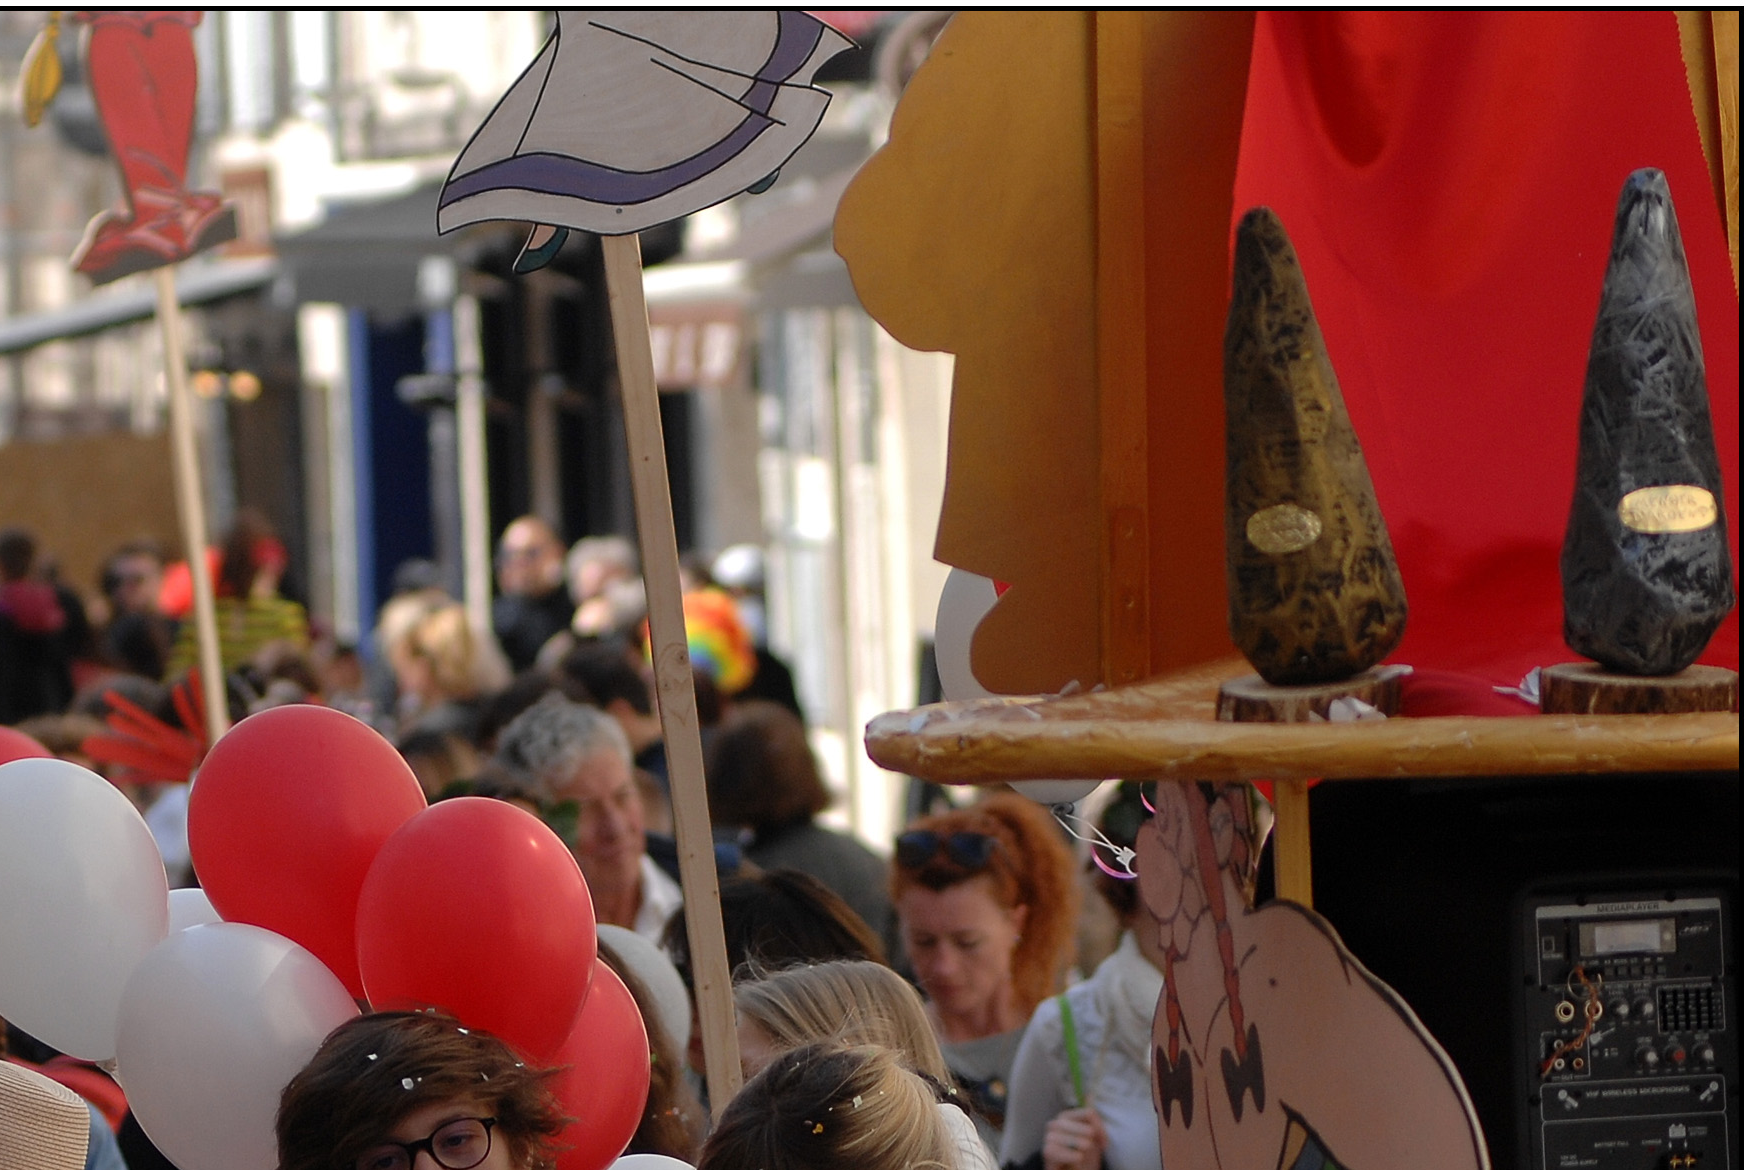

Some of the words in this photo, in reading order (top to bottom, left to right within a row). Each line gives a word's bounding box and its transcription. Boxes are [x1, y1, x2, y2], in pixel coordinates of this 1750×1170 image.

[1596, 902, 1660, 913] MEDIAPLAYER
[1602, 1087, 1637, 1097] WIRELESS
[1639, 1085, 1690, 1096] MICROPHONES
